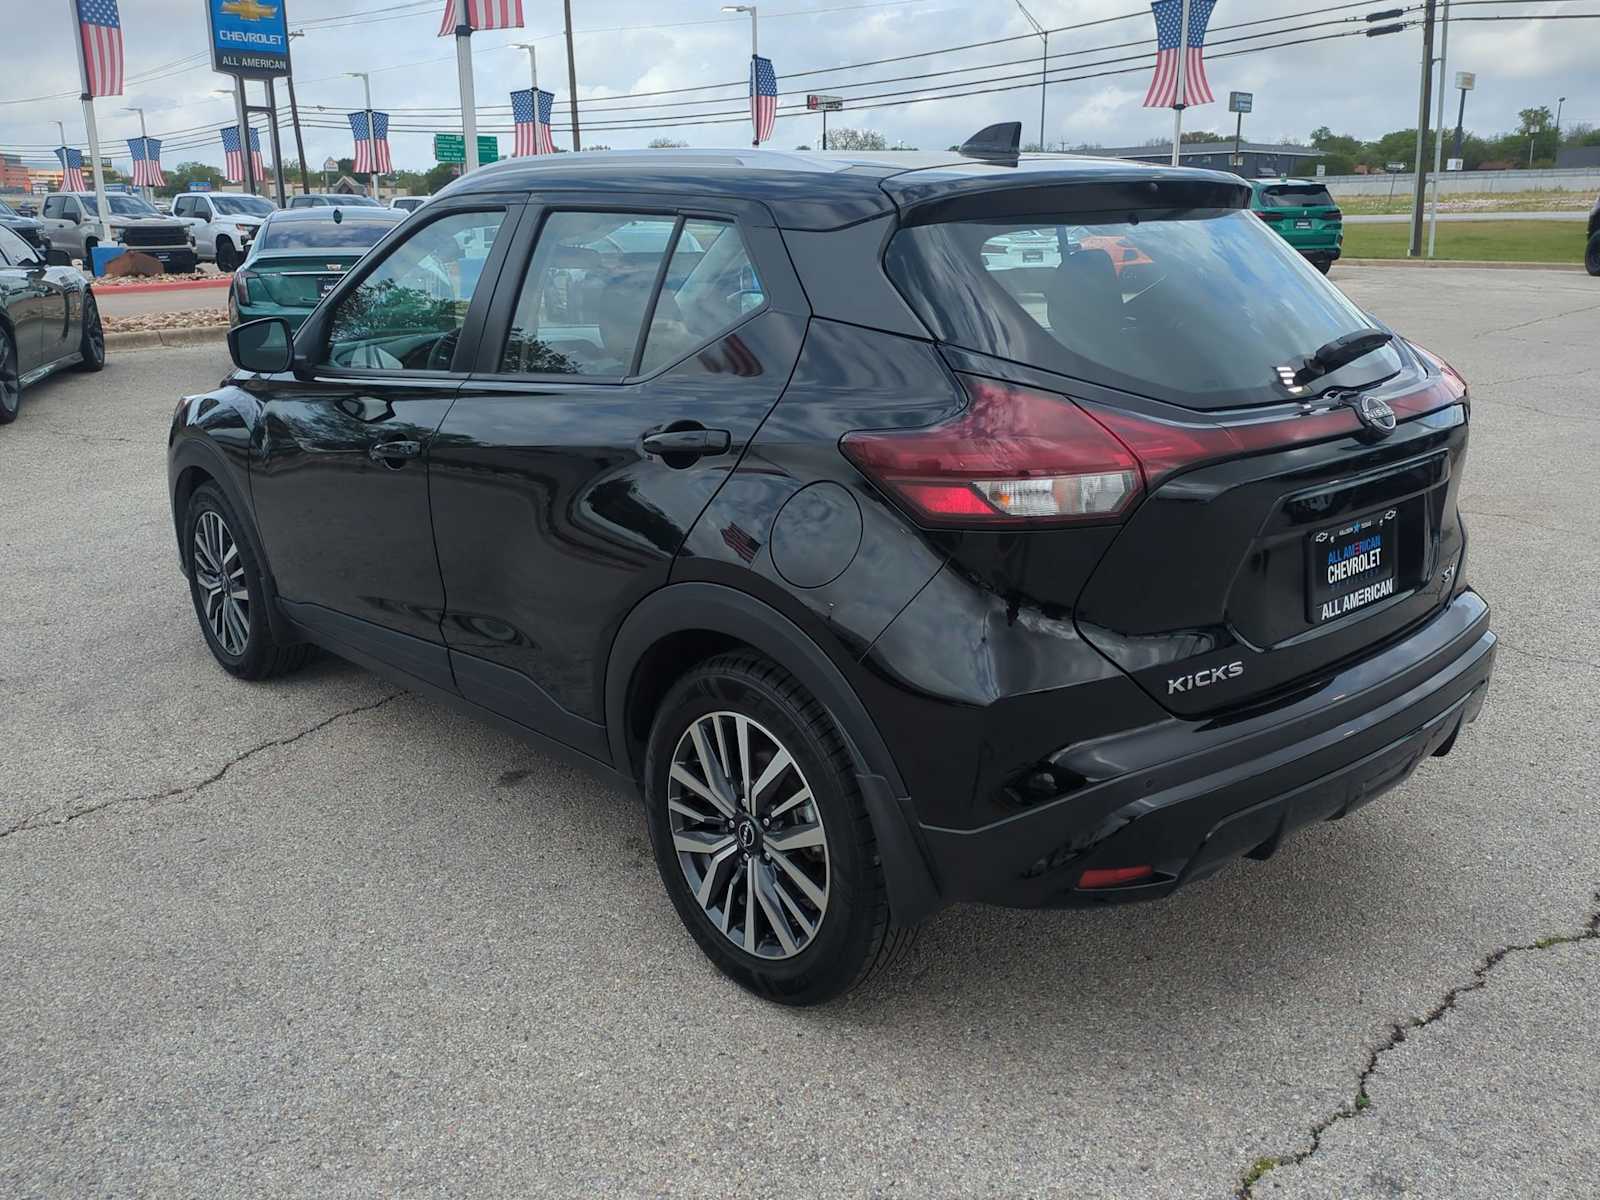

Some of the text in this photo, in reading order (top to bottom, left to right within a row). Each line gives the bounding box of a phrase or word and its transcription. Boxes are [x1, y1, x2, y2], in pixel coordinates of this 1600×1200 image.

[219, 30, 283, 45] CHEVROLET
[222, 55, 287, 70] ALL AMERICAN
[1328, 534, 1381, 565] ALL AMERICAN
[1327, 548, 1382, 584] CHEVROLET
[1321, 600, 1341, 621] ALL
[1342, 578, 1393, 612] AMERICAN
[1167, 661, 1244, 695] KICKS
